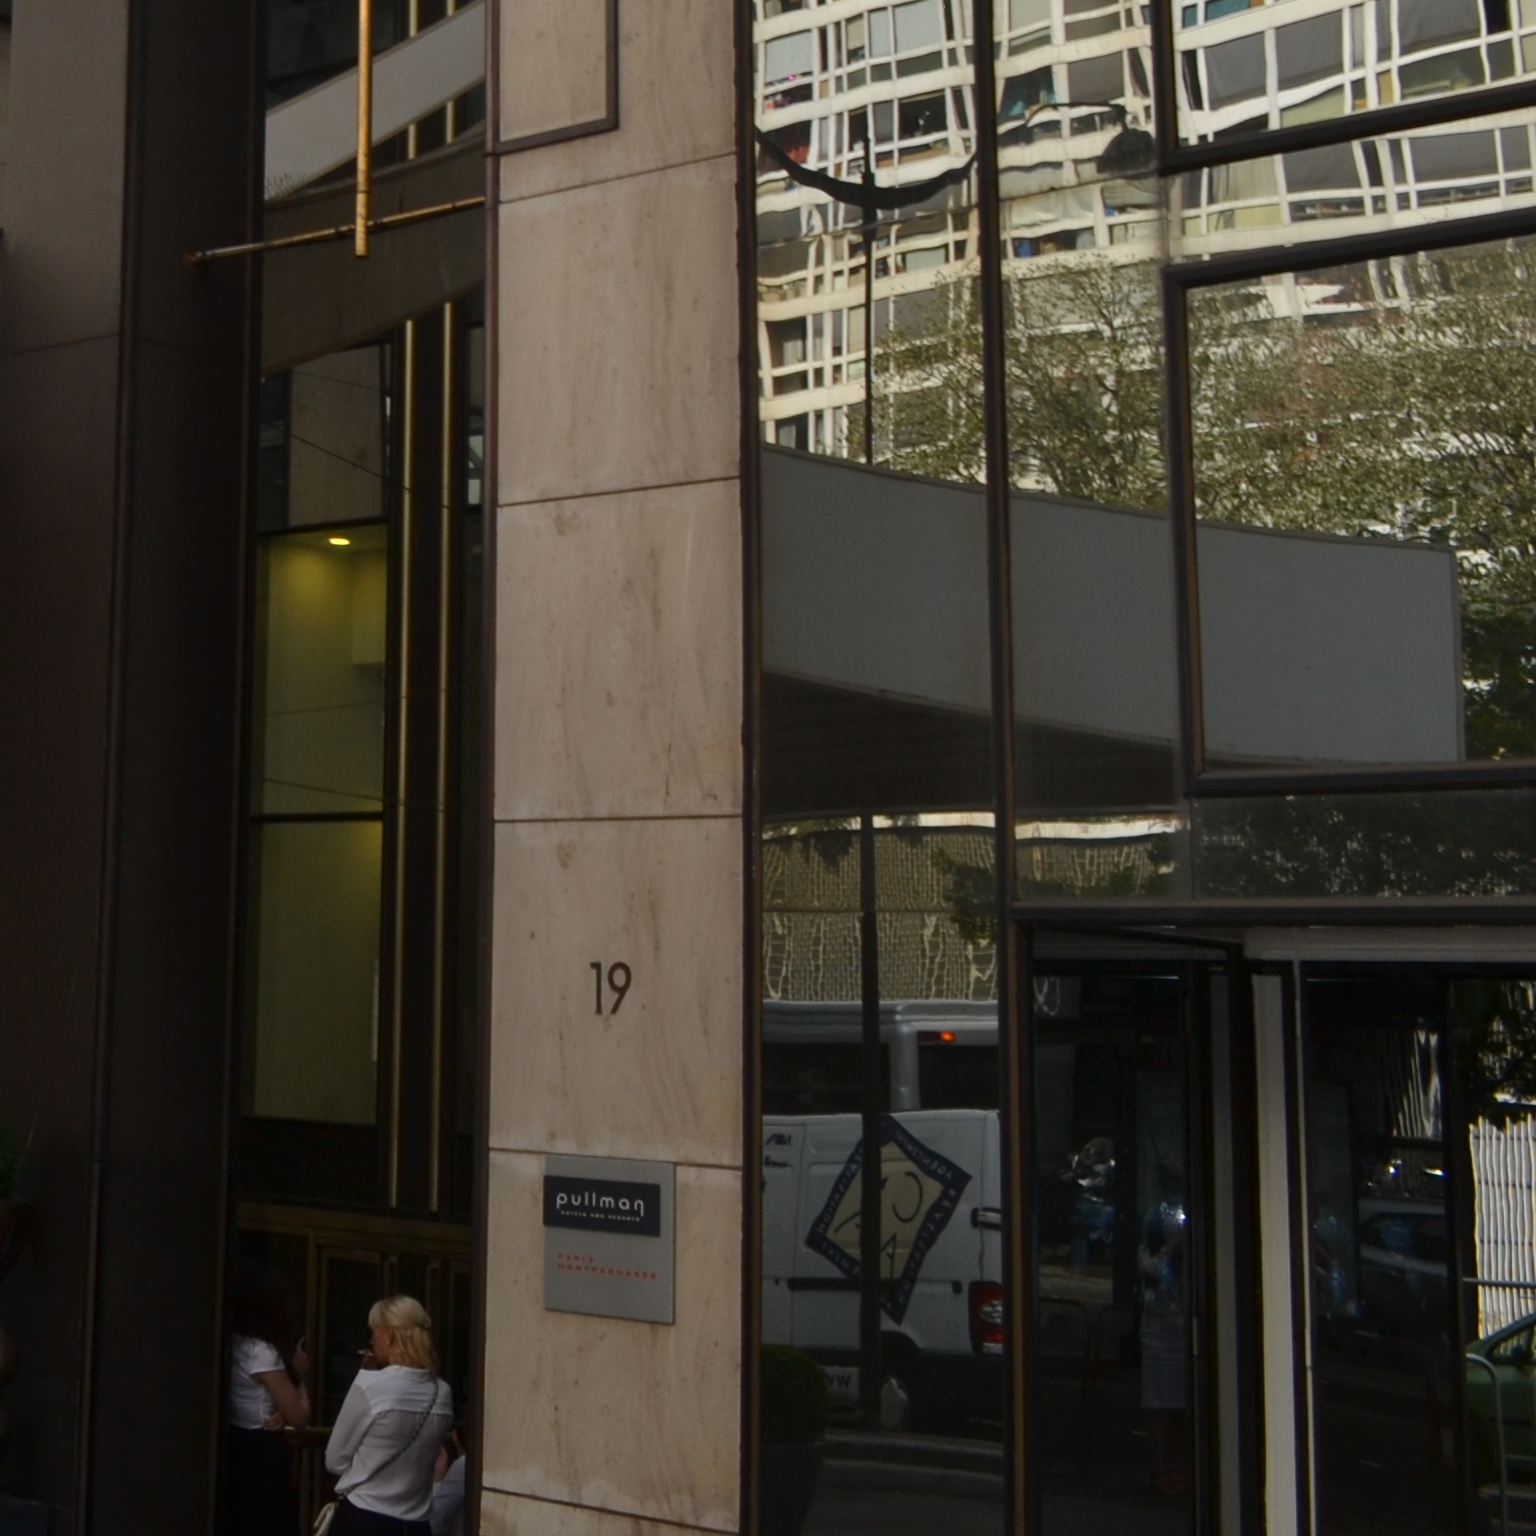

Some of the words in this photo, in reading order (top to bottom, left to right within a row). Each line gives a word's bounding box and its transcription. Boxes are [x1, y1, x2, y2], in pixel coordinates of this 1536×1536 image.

[590, 961, 632, 1015] 19
[556, 1191, 645, 1217] pullman
[557, 1253, 595, 1264] PARIS
[557, 1263, 658, 1280] MONTPARNASSE
